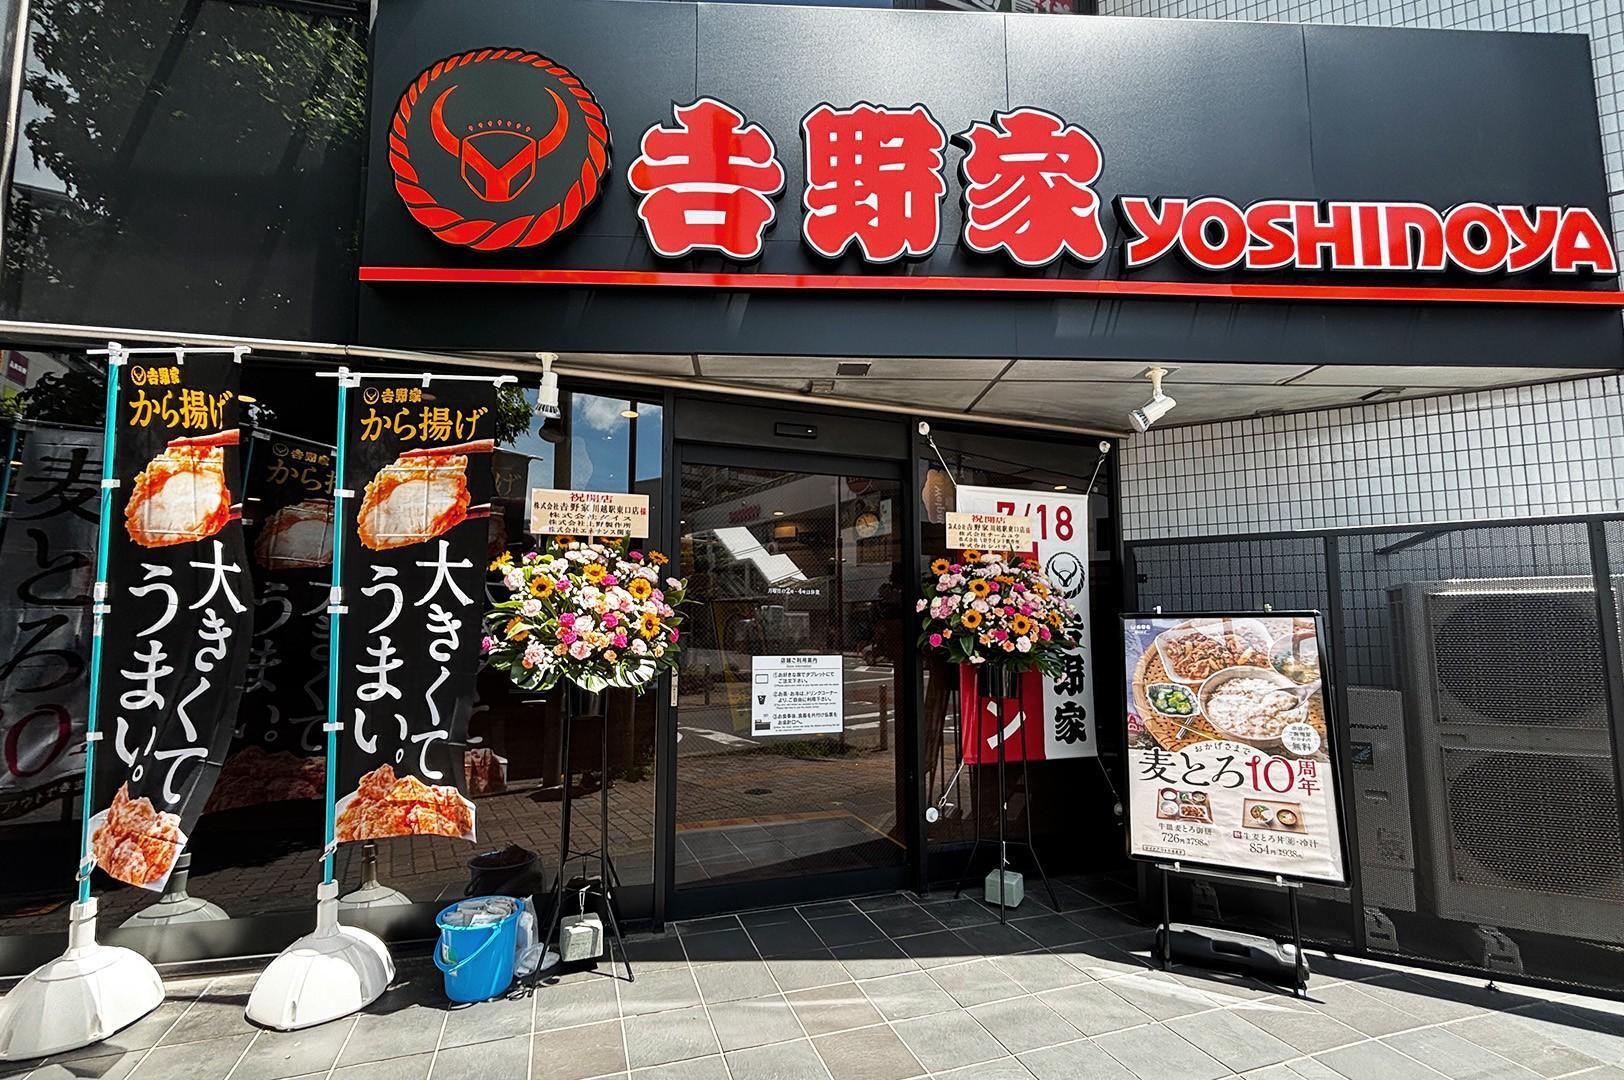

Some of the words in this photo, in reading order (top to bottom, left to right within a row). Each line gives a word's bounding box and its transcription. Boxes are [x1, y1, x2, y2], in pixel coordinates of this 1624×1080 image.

[1120, 197, 1617, 272] YOSHINOYA
[129, 387, 234, 430] から揚げ
[360, 405, 489, 442] から揚げ
[569, 492, 614, 503] 祝開店
[114, 563, 178, 782] うまい。
[155, 540, 247, 805] 大きくて
[354, 564, 408, 764] うまい。
[411, 540, 475, 780] 大きくて
